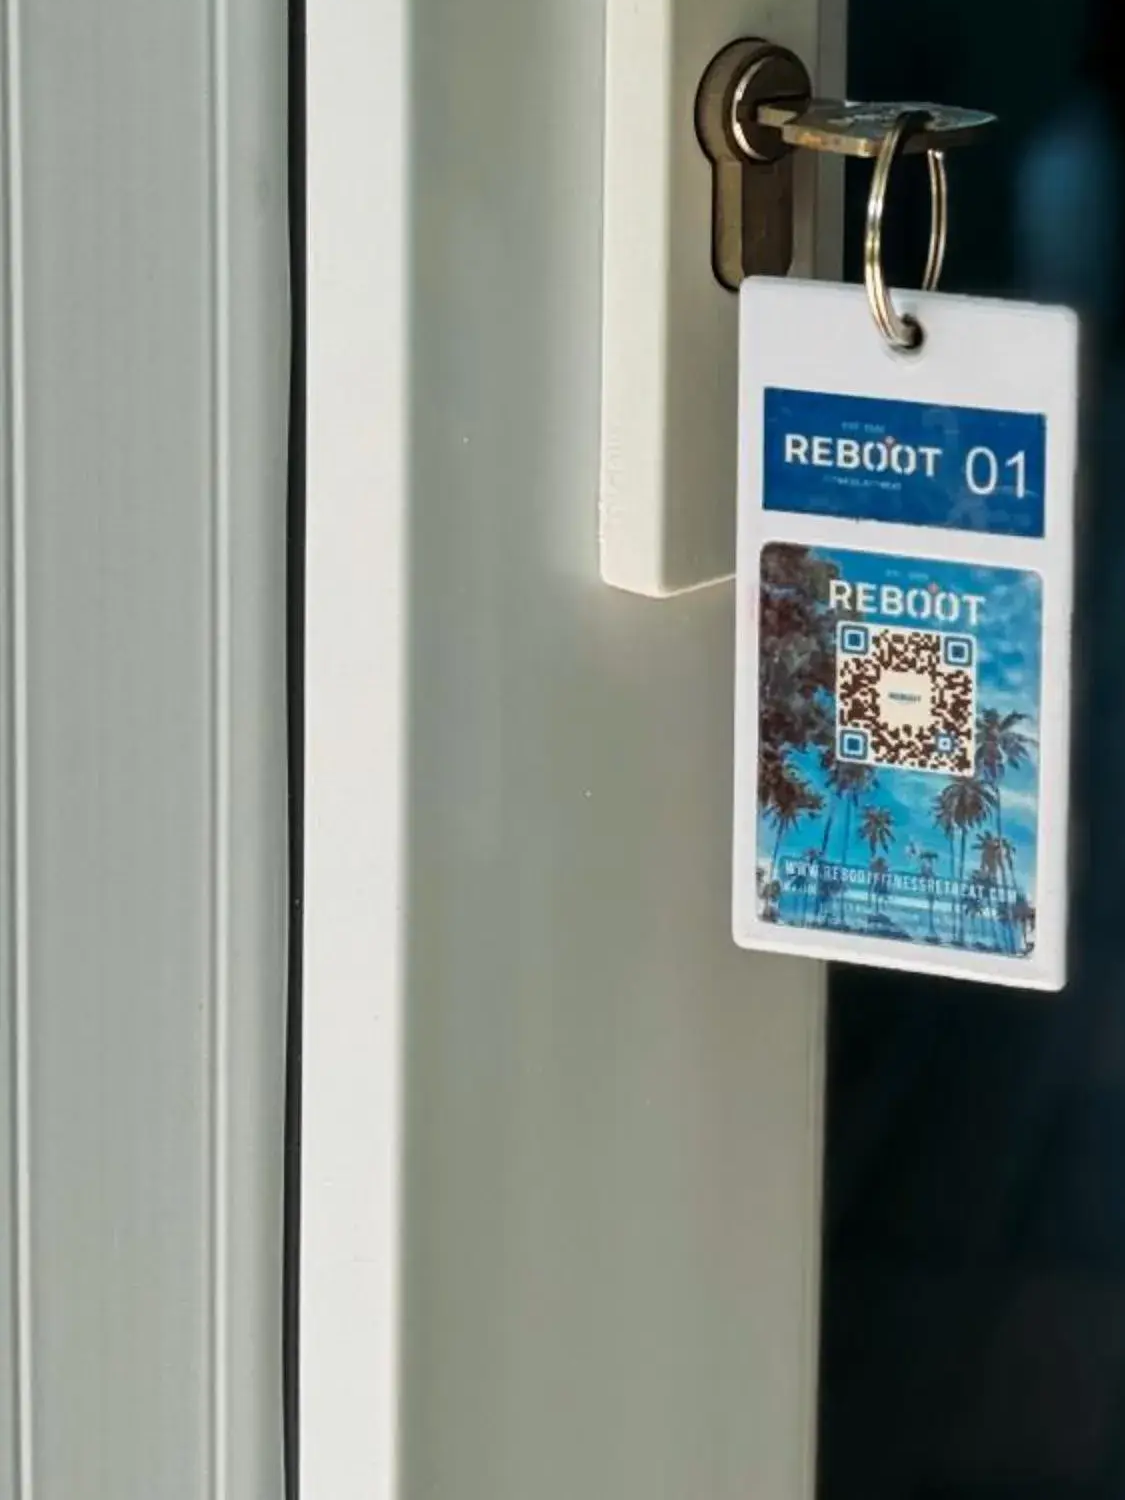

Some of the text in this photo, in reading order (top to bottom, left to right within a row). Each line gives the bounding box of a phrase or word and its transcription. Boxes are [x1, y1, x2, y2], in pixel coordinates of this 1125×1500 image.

[783, 432, 1027, 499] REBOOT 01
[828, 578, 986, 626] REBOOT
